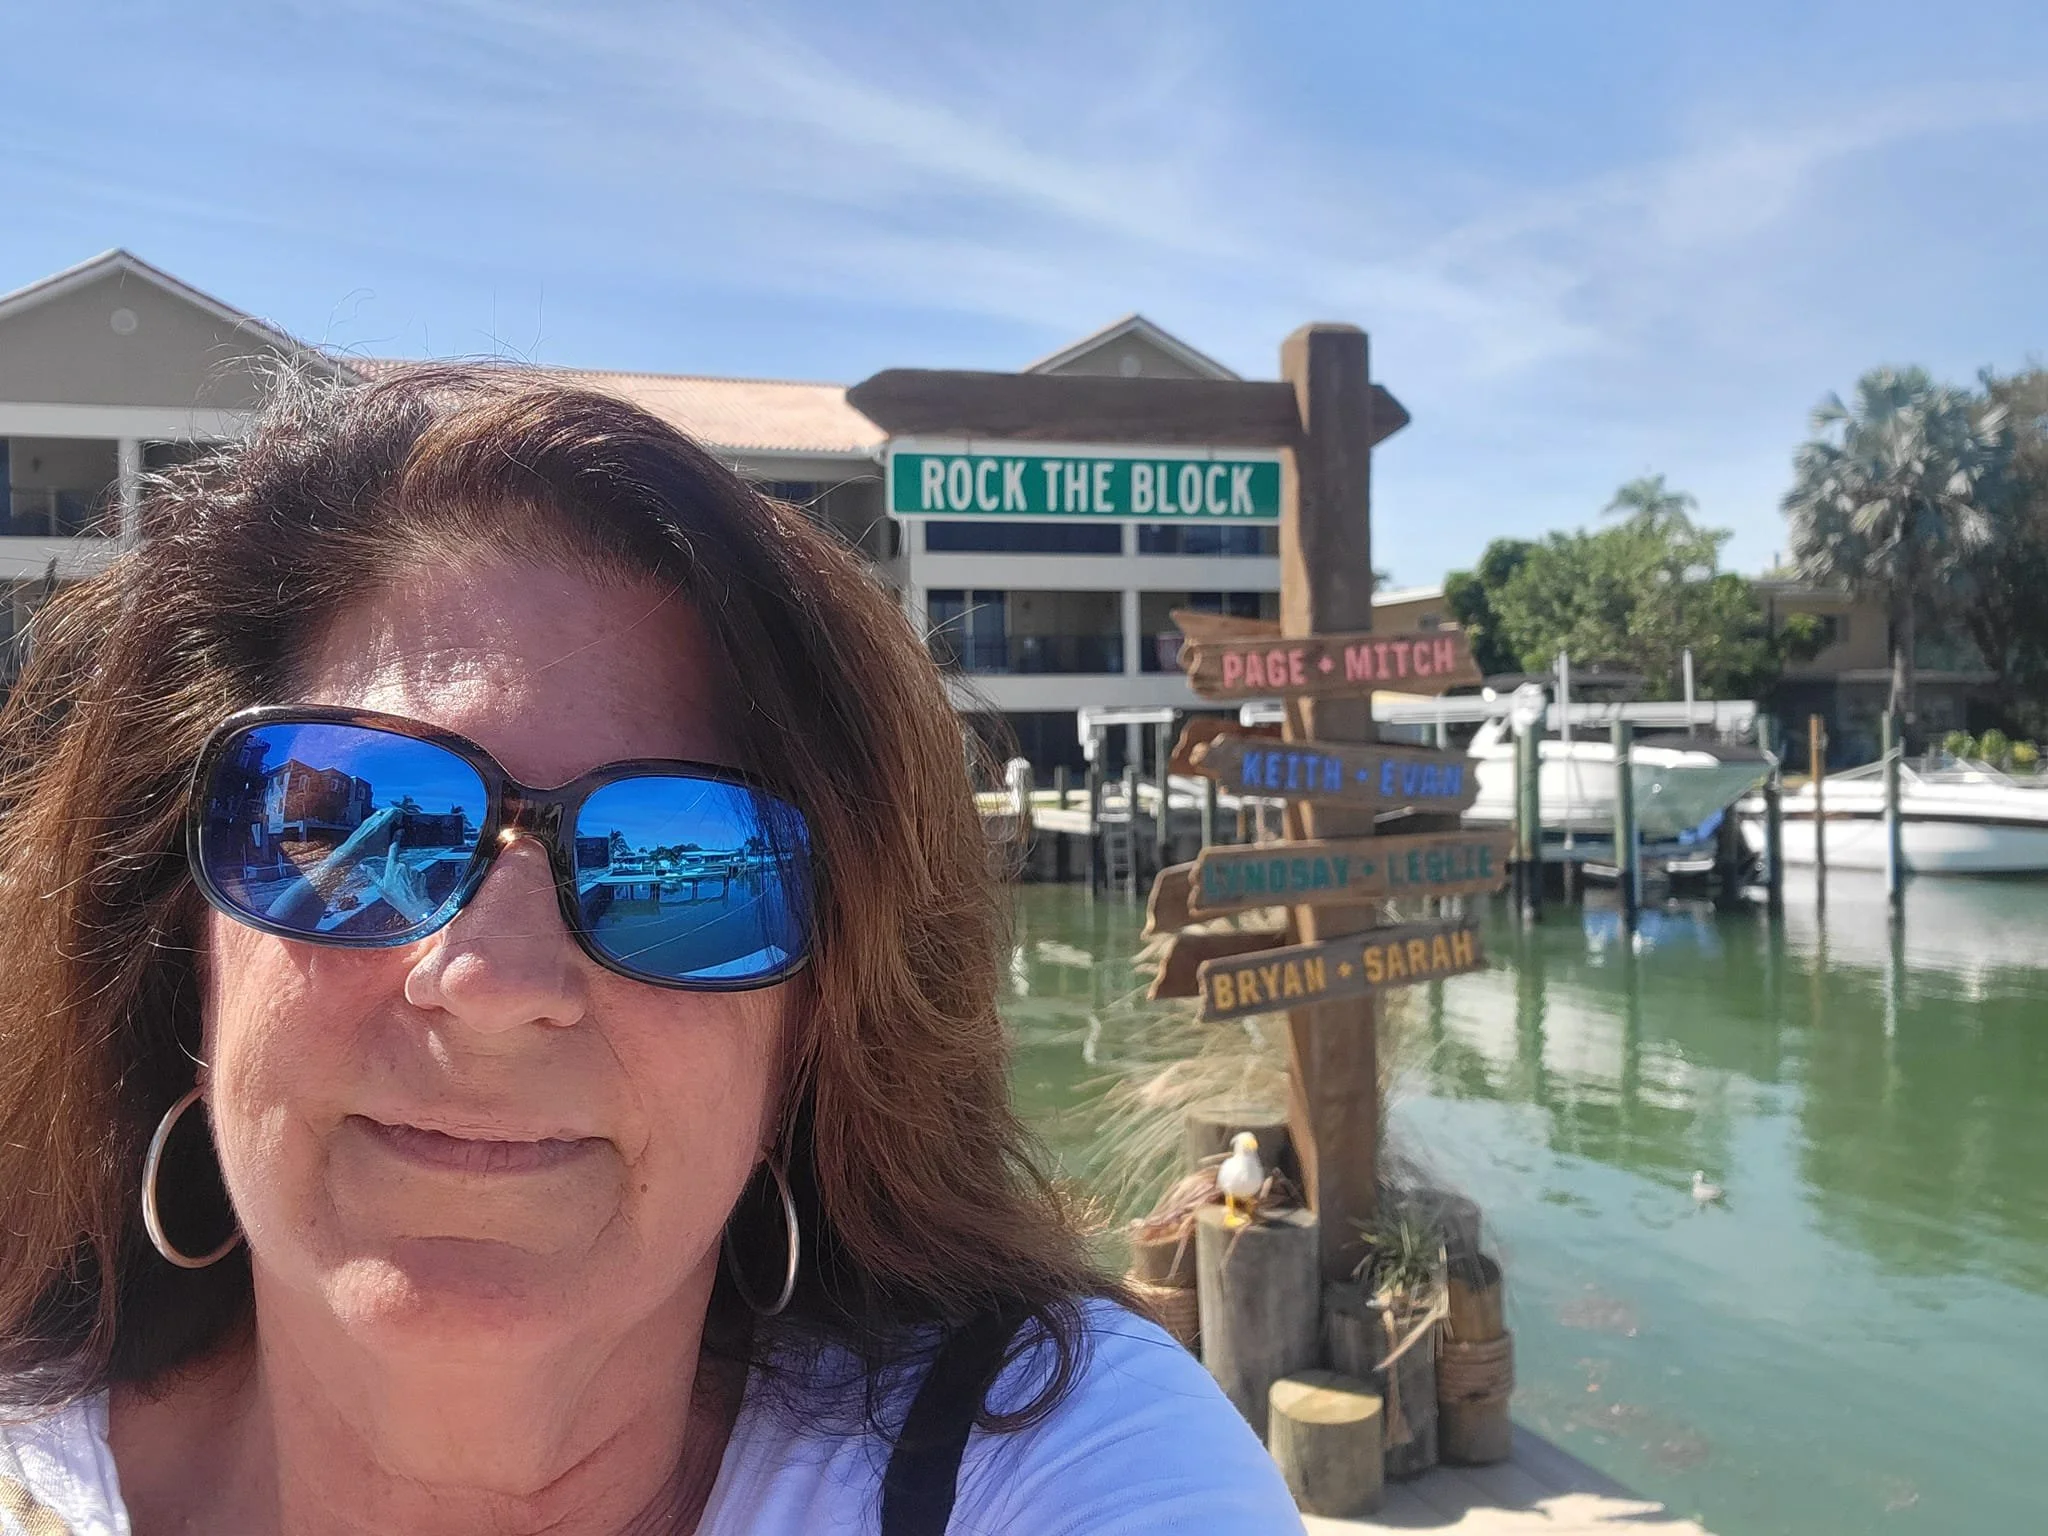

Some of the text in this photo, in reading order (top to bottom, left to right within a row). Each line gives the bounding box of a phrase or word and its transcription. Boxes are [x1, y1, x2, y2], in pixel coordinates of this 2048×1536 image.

[920, 458, 1256, 516] ROCK THE BLOCK
[1221, 637, 1456, 688] PAGE MITCH
[1242, 751, 1463, 797] KEITH EVAN
[1211, 930, 1474, 1011] BRYAN SARAH
